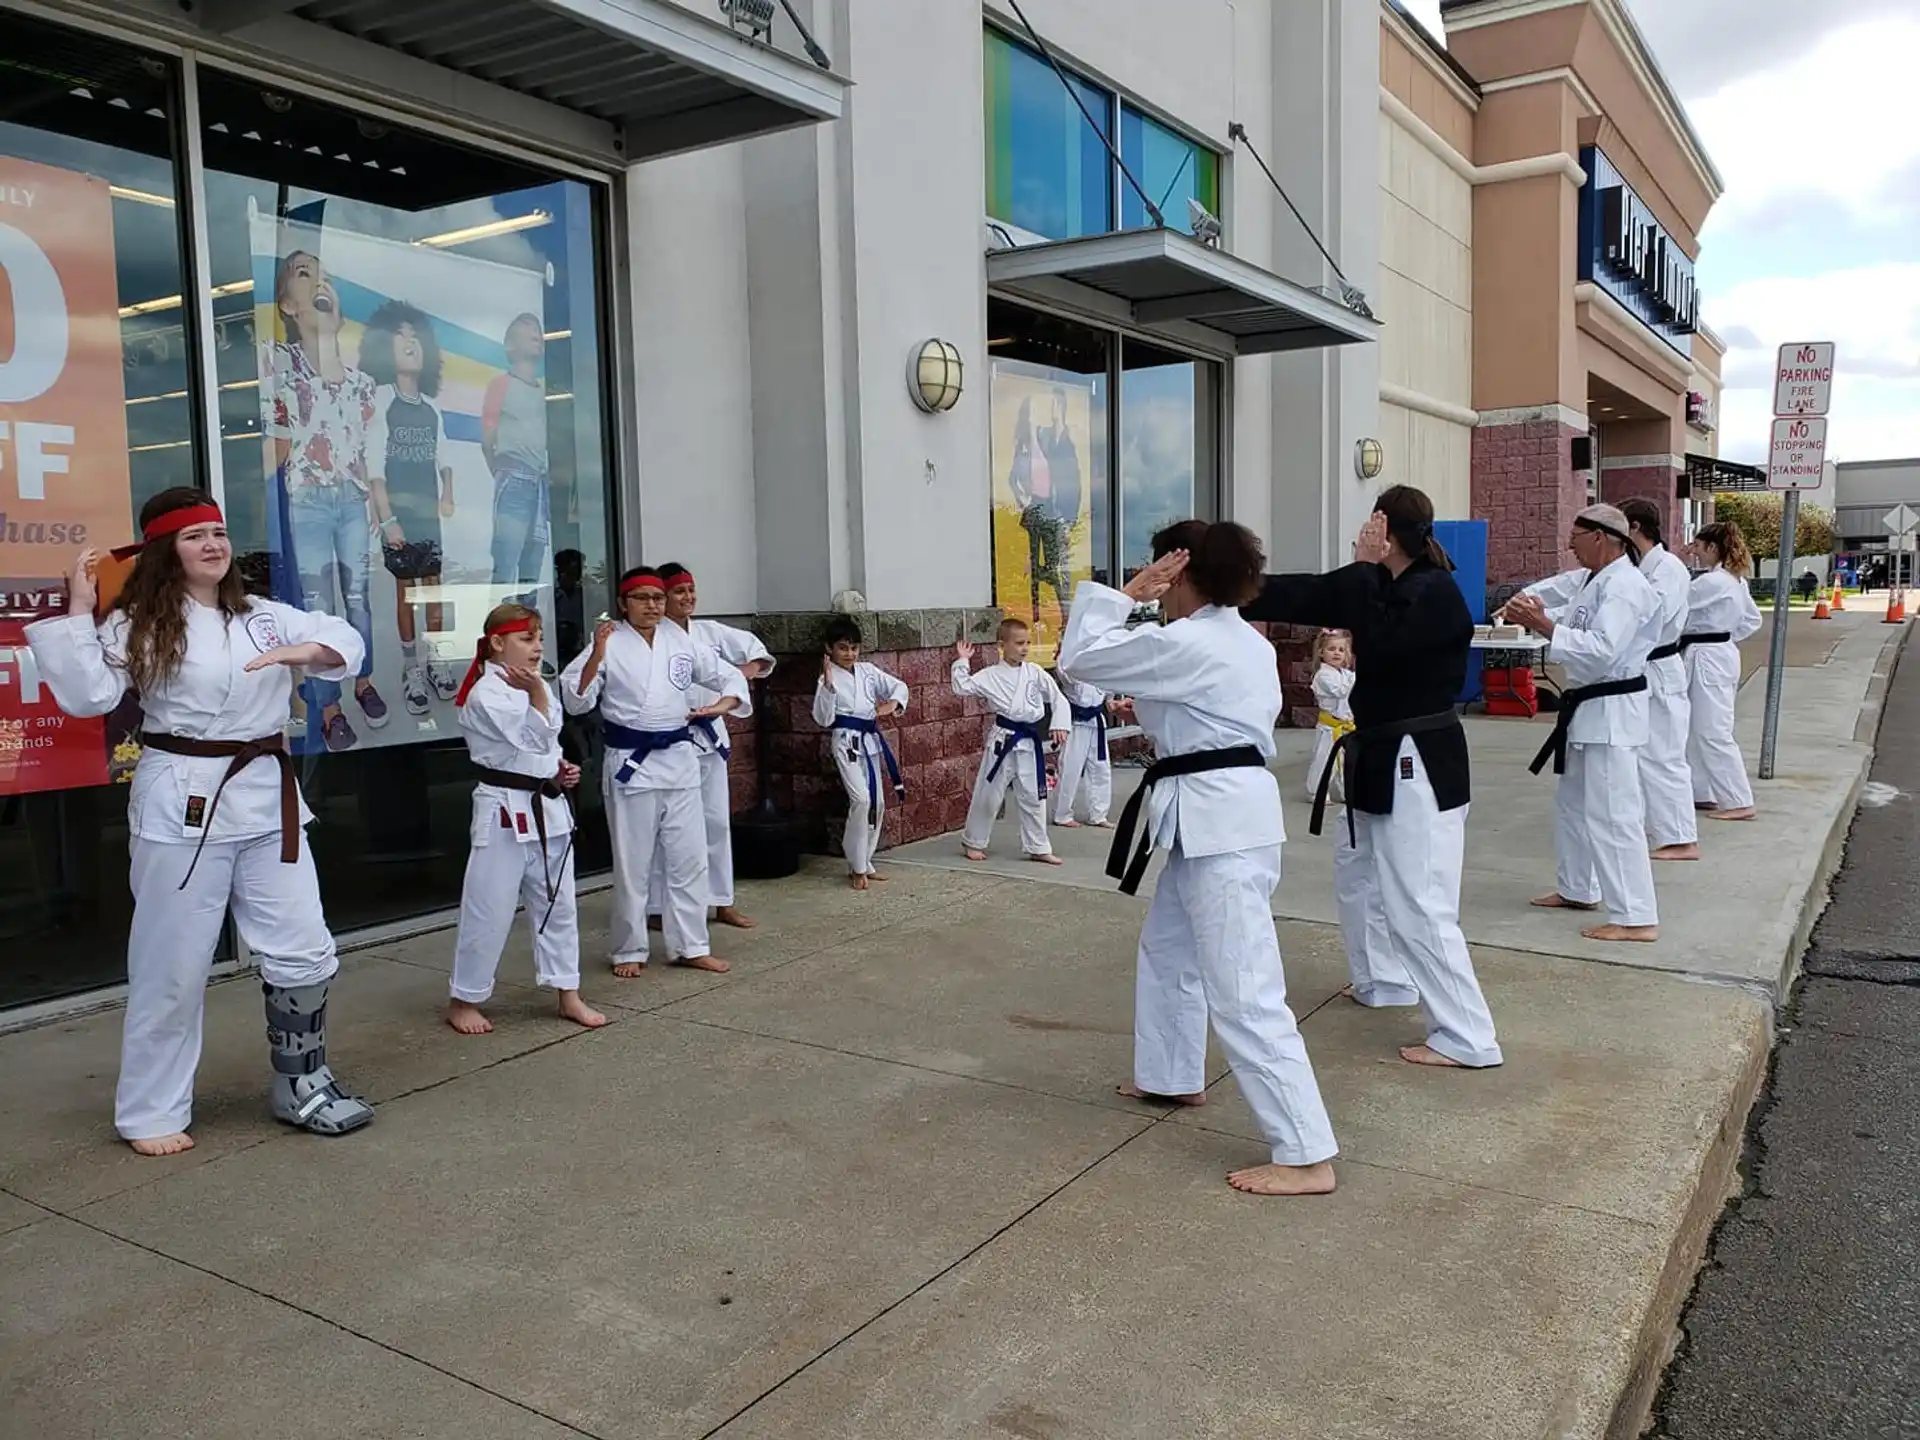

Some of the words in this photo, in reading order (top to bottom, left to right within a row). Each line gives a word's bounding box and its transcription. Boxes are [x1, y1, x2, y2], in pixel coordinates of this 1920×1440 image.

[1796, 349, 1816, 364] NO
[1779, 367, 1831, 383] PARKING
[1790, 386, 1815, 397] FIRE
[1787, 399, 1815, 410] LANE
[1789, 424, 1809, 439] NO
[1774, 439, 1823, 451] STOPPING
[1790, 453, 1804, 463] OR
[1772, 464, 1820, 476] STANDING
[36, 716, 65, 729] any
